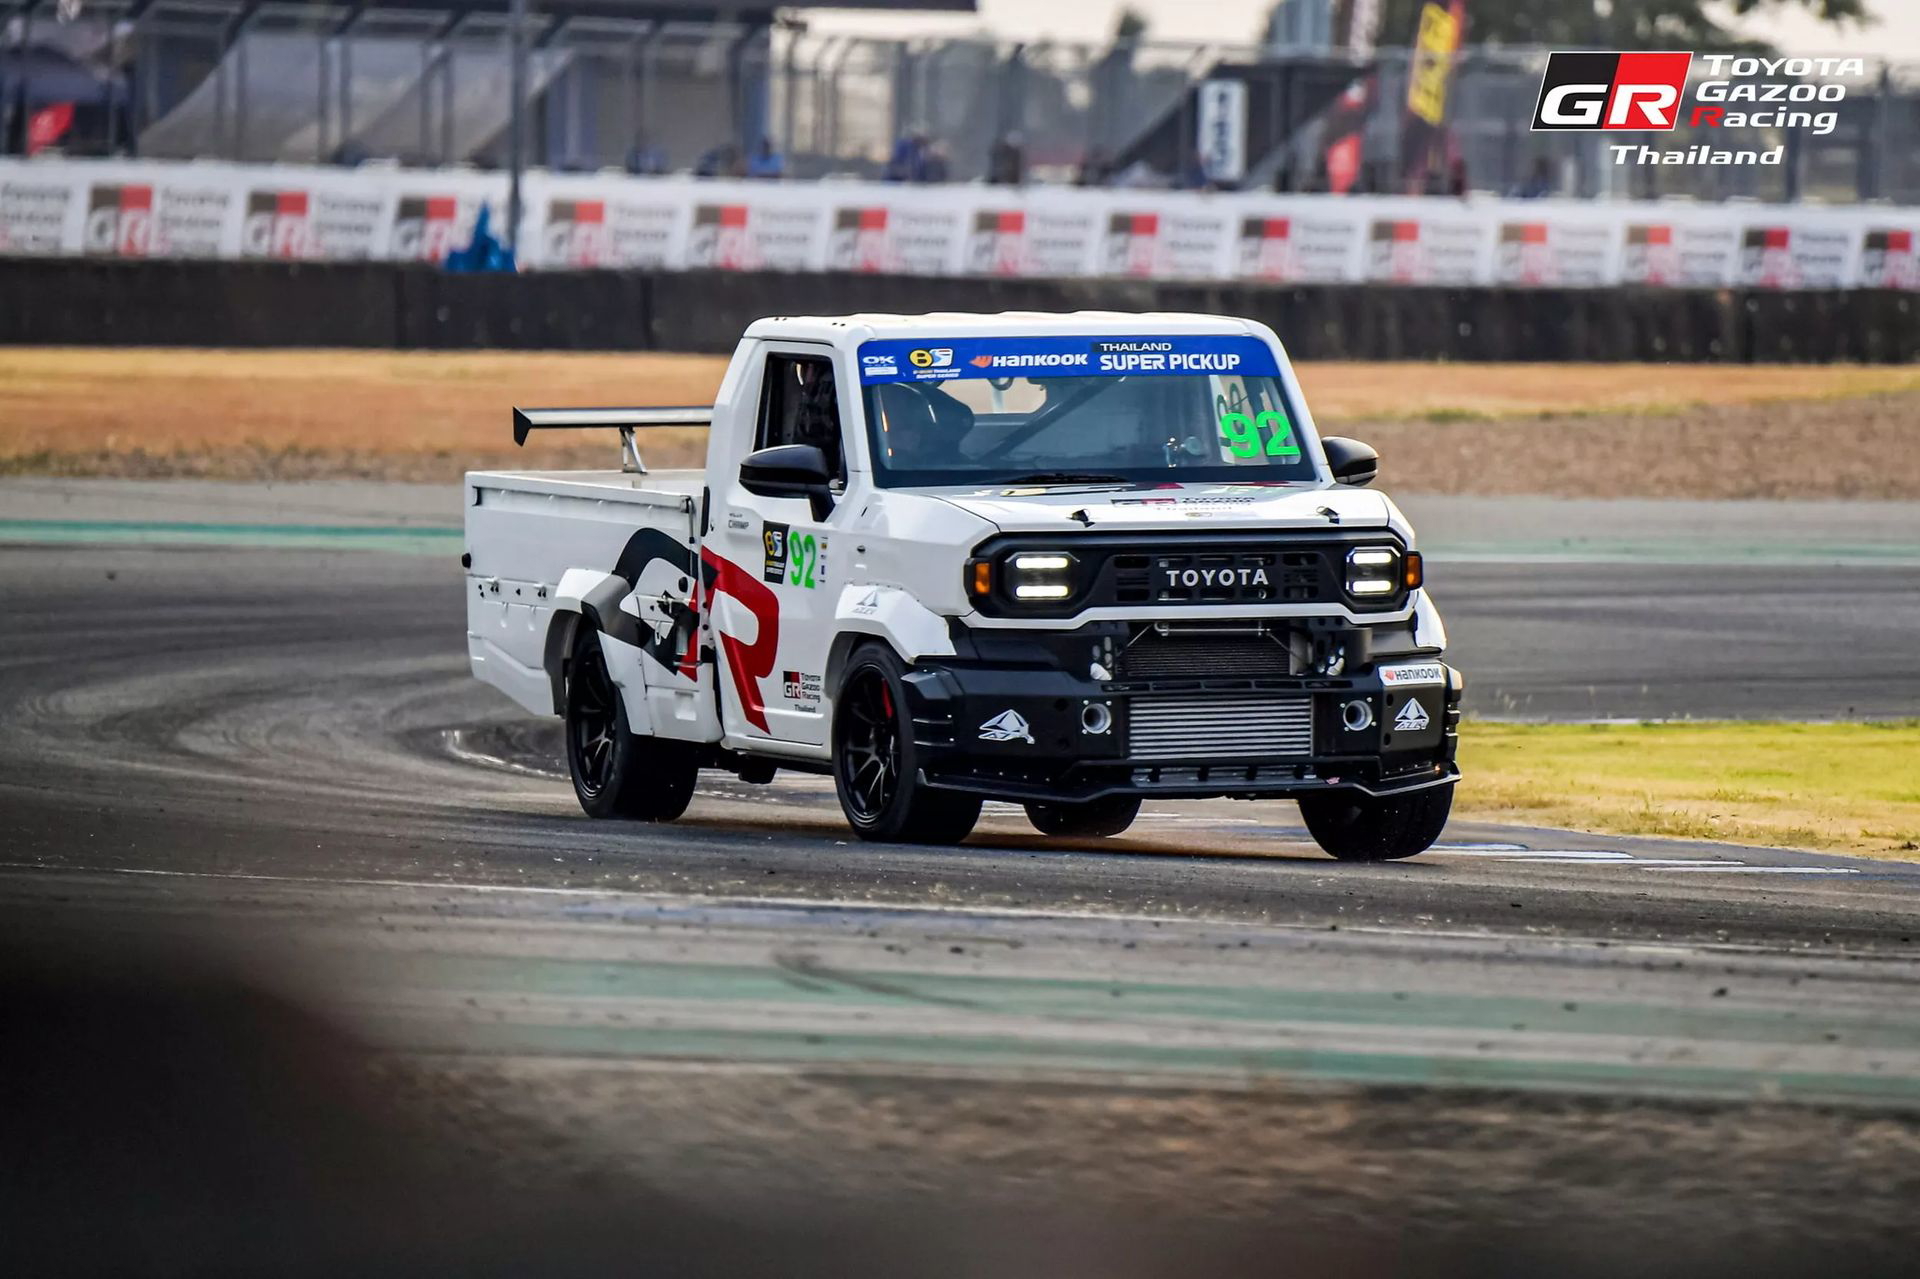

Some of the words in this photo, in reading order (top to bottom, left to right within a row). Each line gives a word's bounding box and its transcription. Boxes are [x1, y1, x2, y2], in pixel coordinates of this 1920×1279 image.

[1100, 342, 1172, 352] THAILAND
[862, 355, 896, 365] OK
[1100, 354, 1165, 371] SUPER
[1169, 353, 1241, 370] PICKUP
[1220, 409, 1300, 458] 92
[789, 531, 816, 589] 92
[1166, 569, 1269, 587] TOYOTA
[784, 682, 800, 697] GR
